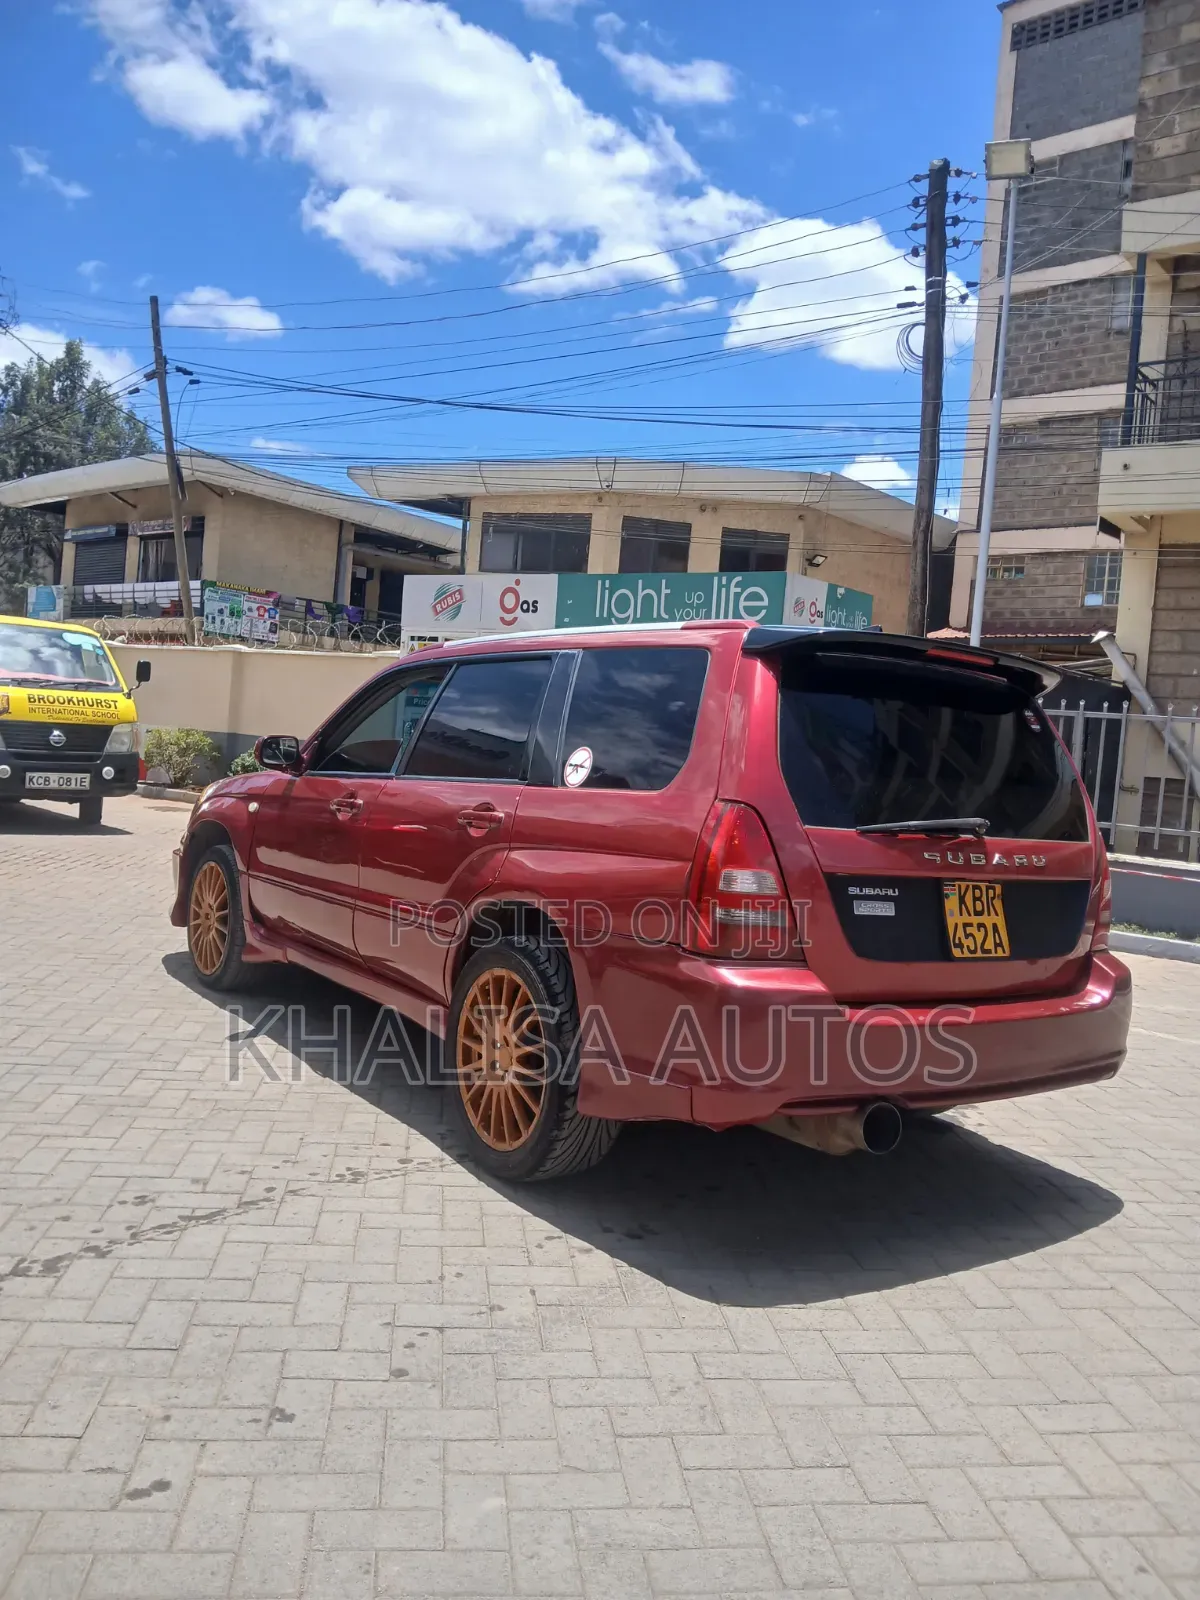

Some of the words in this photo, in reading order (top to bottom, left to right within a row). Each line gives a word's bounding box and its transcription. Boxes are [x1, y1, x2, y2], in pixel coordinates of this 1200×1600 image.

[435, 591, 461, 613] RUBIS
[499, 578, 539, 626] gas
[595, 579, 671, 625] light
[685, 591, 704, 604] up
[711, 576, 769, 621] life
[674, 607, 707, 621] your
[826, 604, 846, 628] light
[854, 610, 868, 630] life
[27, 693, 119, 710] BROOKHURST
[28, 706, 90, 717] INTERNATIONAL
[91, 710, 121, 720] SCHOOL
[28, 775, 51, 787] KCB
[57, 776, 88, 788] 081E
[923, 851, 1046, 867] SUBARU
[848, 886, 899, 896] SUBARU
[957, 884, 999, 917] KBR
[951, 922, 1006, 955] 452A
